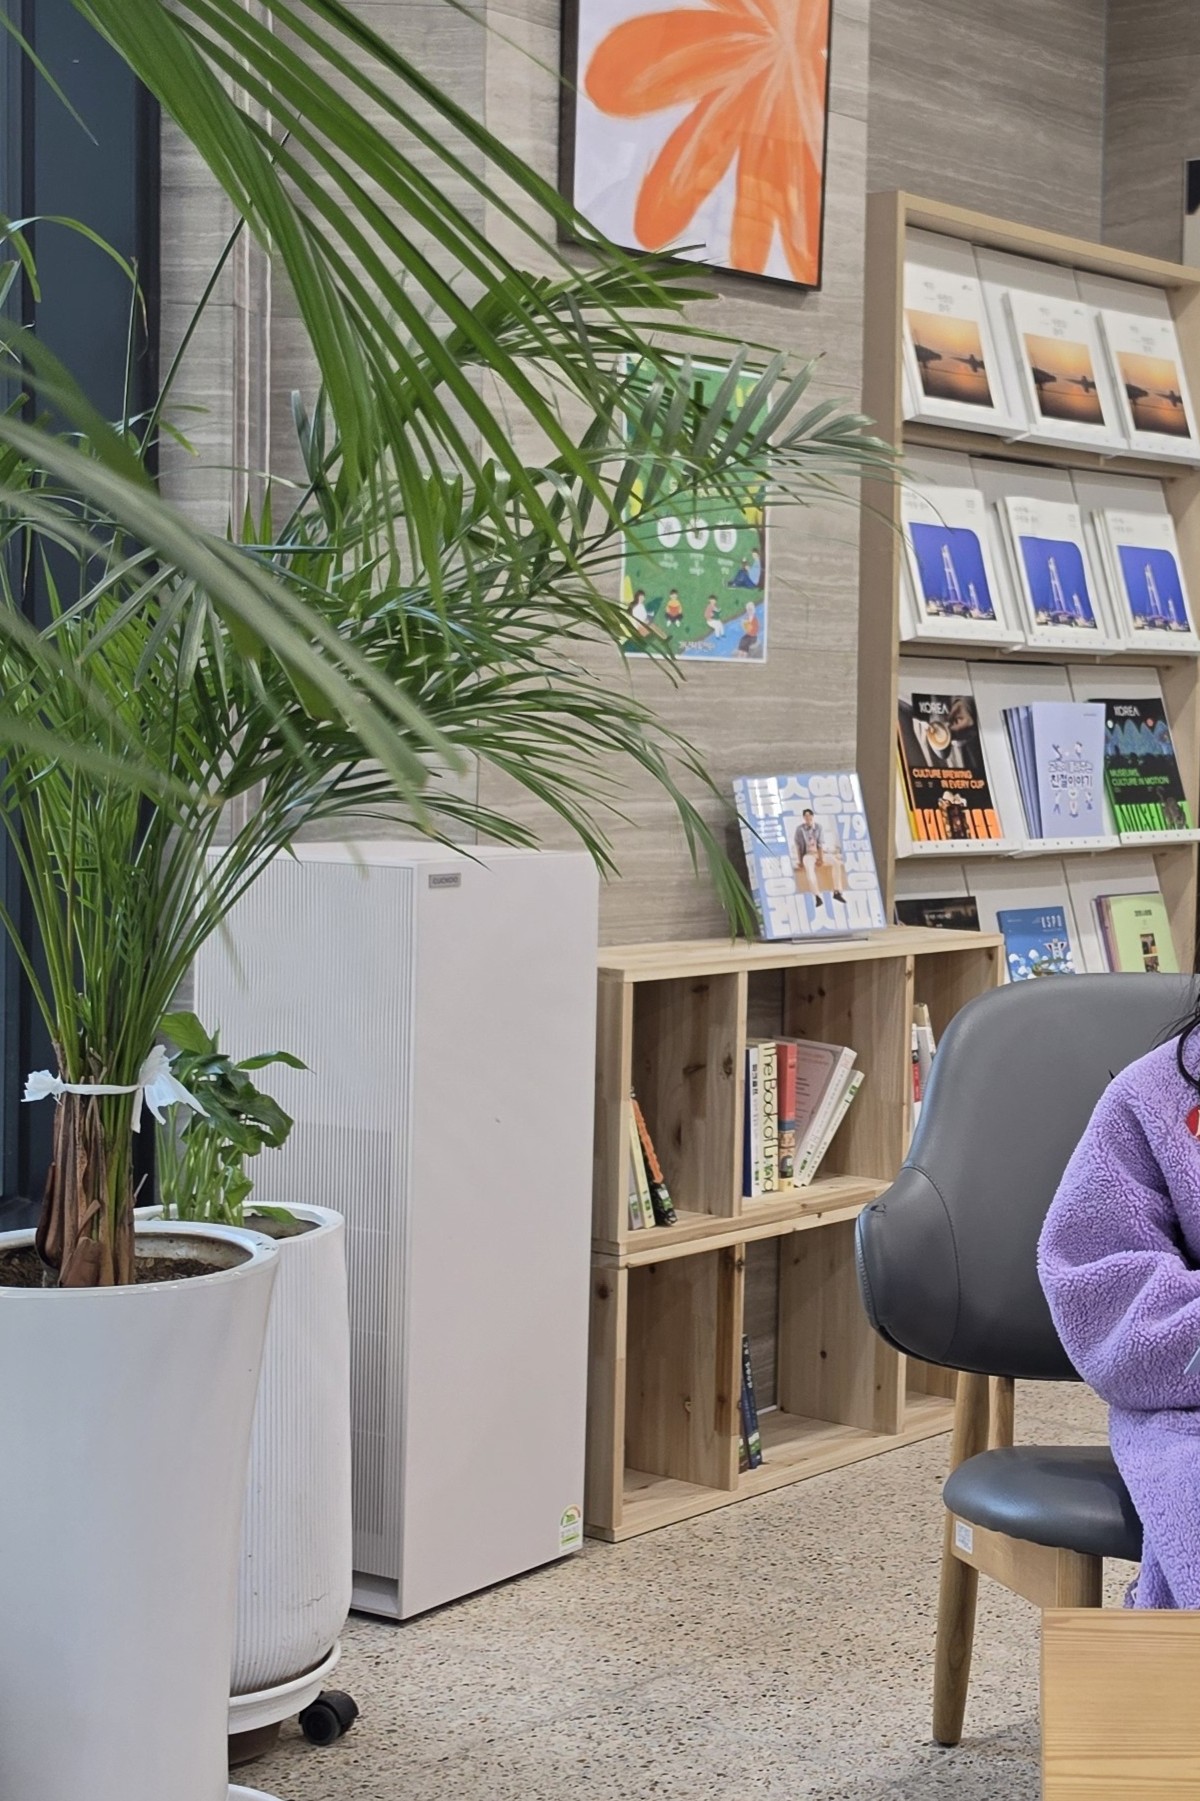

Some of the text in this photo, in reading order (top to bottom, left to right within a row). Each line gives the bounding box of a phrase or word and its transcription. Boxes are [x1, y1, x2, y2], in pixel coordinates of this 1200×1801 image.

[918, 702, 950, 715] KOREA
[1113, 706, 1140, 717] KOREA
[912, 768, 941, 778] CULTURE
[949, 779, 970, 789] EVERY
[970, 780, 985, 789] CUP
[1111, 777, 1138, 787] CULTURE
[1144, 775, 1170, 786] MOTION
[838, 814, 866, 840] 79
[765, 888, 886, 936] 레시피
[763, 1047, 776, 1076] The
[763, 1078, 778, 1123] Book
[763, 1125, 778, 1141] of
